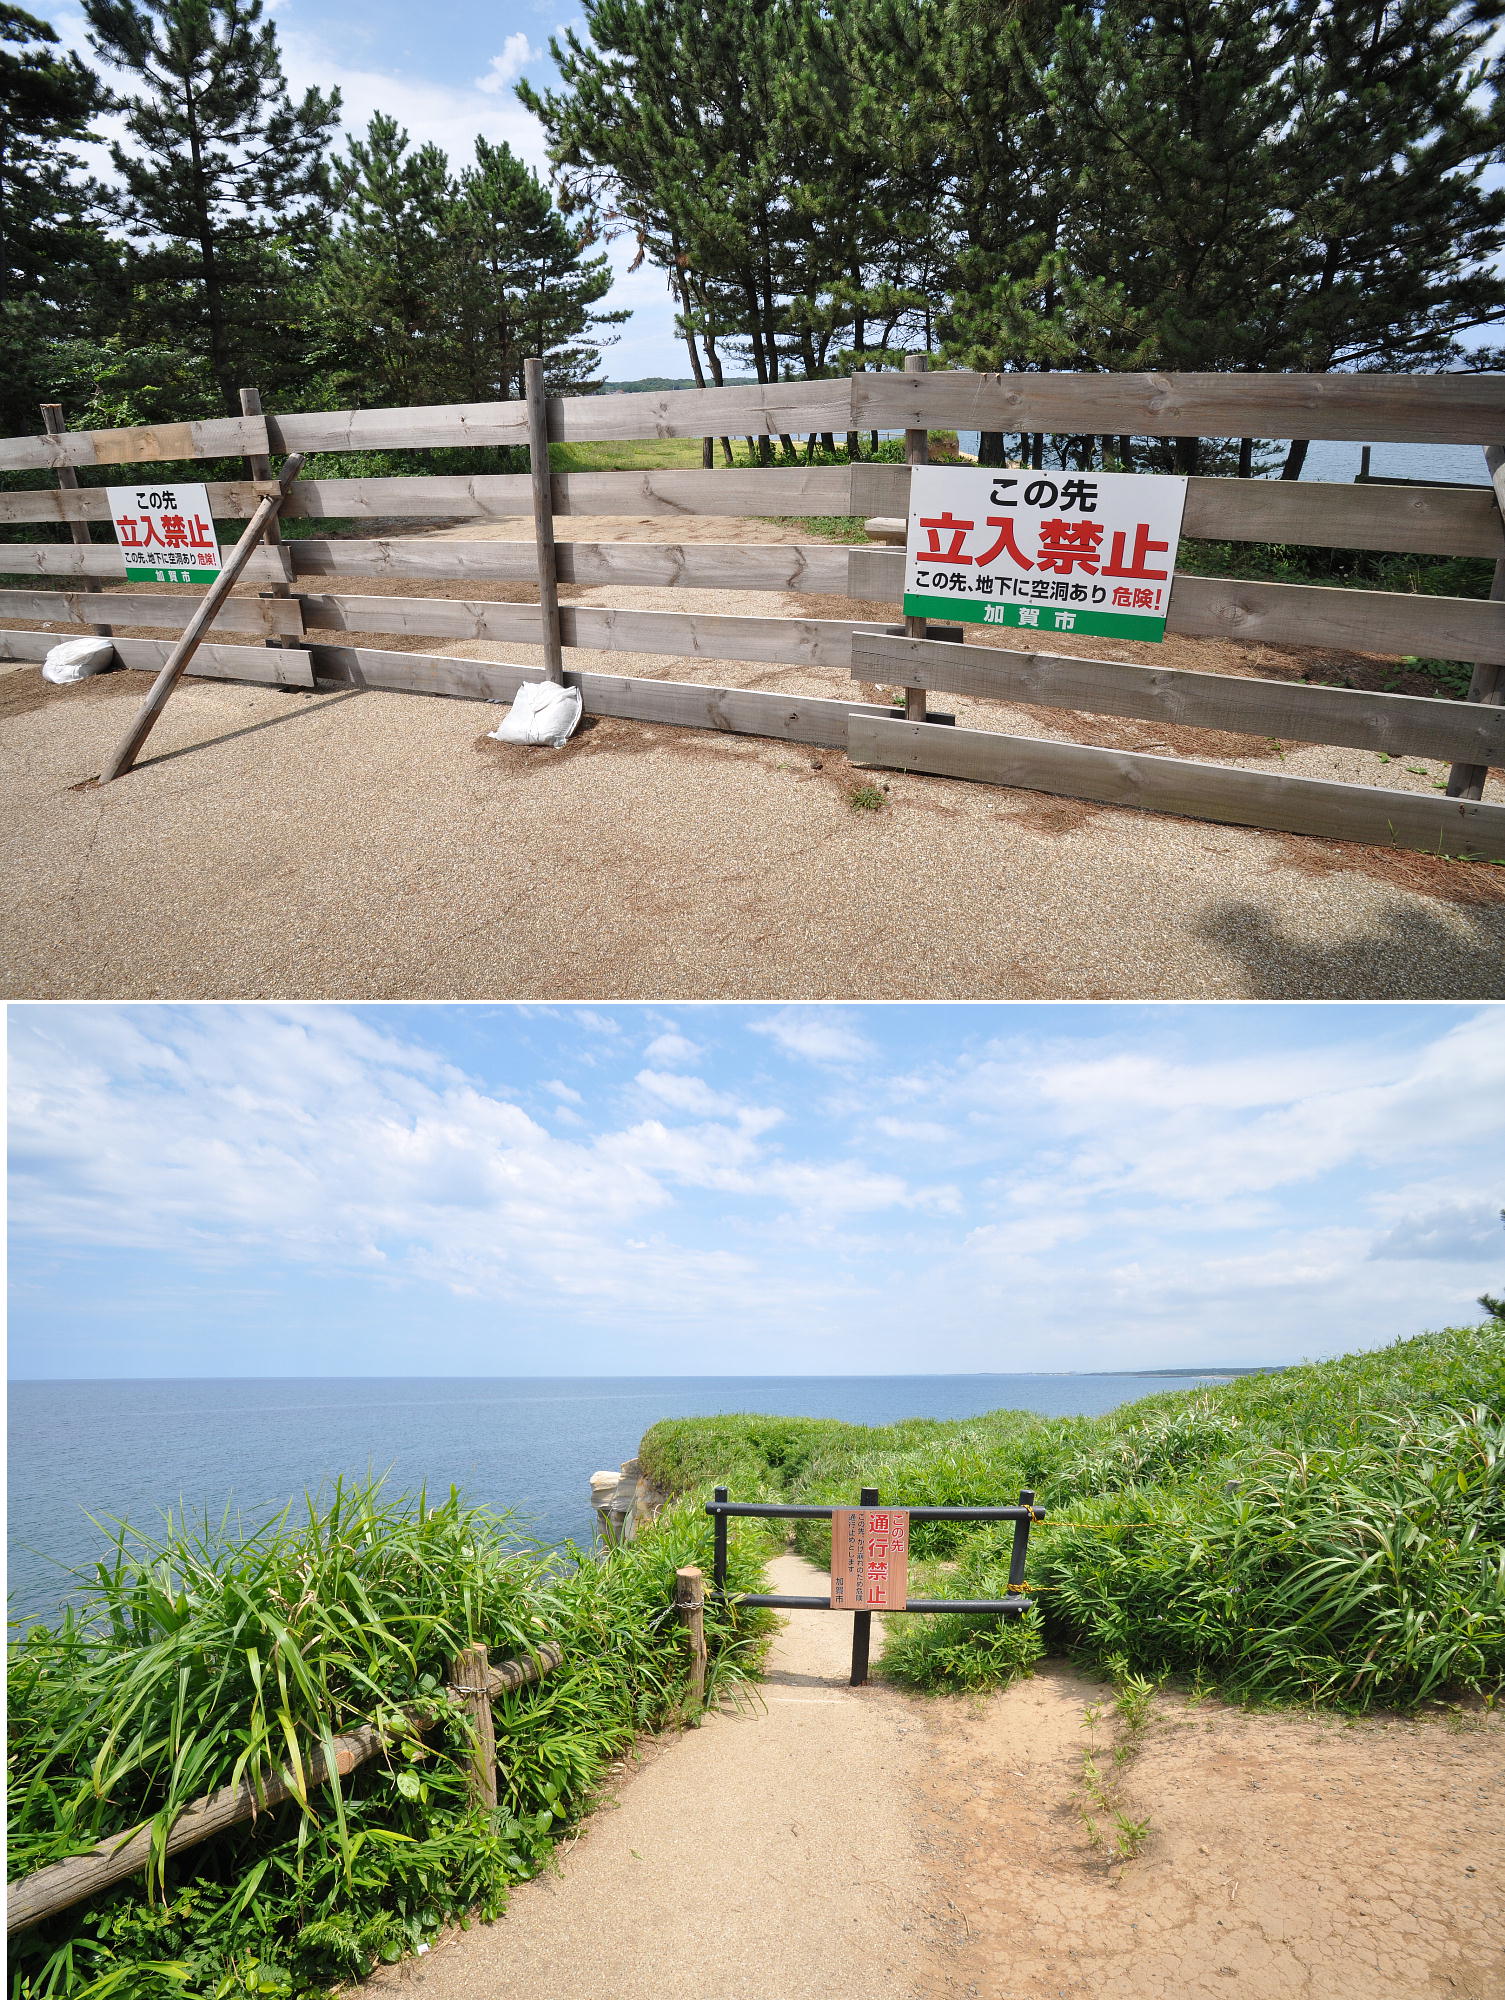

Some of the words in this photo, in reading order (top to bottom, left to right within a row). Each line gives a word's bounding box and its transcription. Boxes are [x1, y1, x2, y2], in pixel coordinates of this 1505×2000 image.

[136, 490, 177, 510] この先
[990, 478, 1098, 512] この先
[116, 514, 214, 548] 立入禁止
[917, 512, 1169, 581] 立入禁止
[155, 570, 191, 583] 加賀市
[915, 570, 1106, 604] この先、地下に空洞あり
[1111, 586, 1161, 611] 危険!
[984, 604, 1077, 631] 加賀市
[891, 1514, 904, 1553] この先
[867, 1513, 889, 1605] 通行禁止
